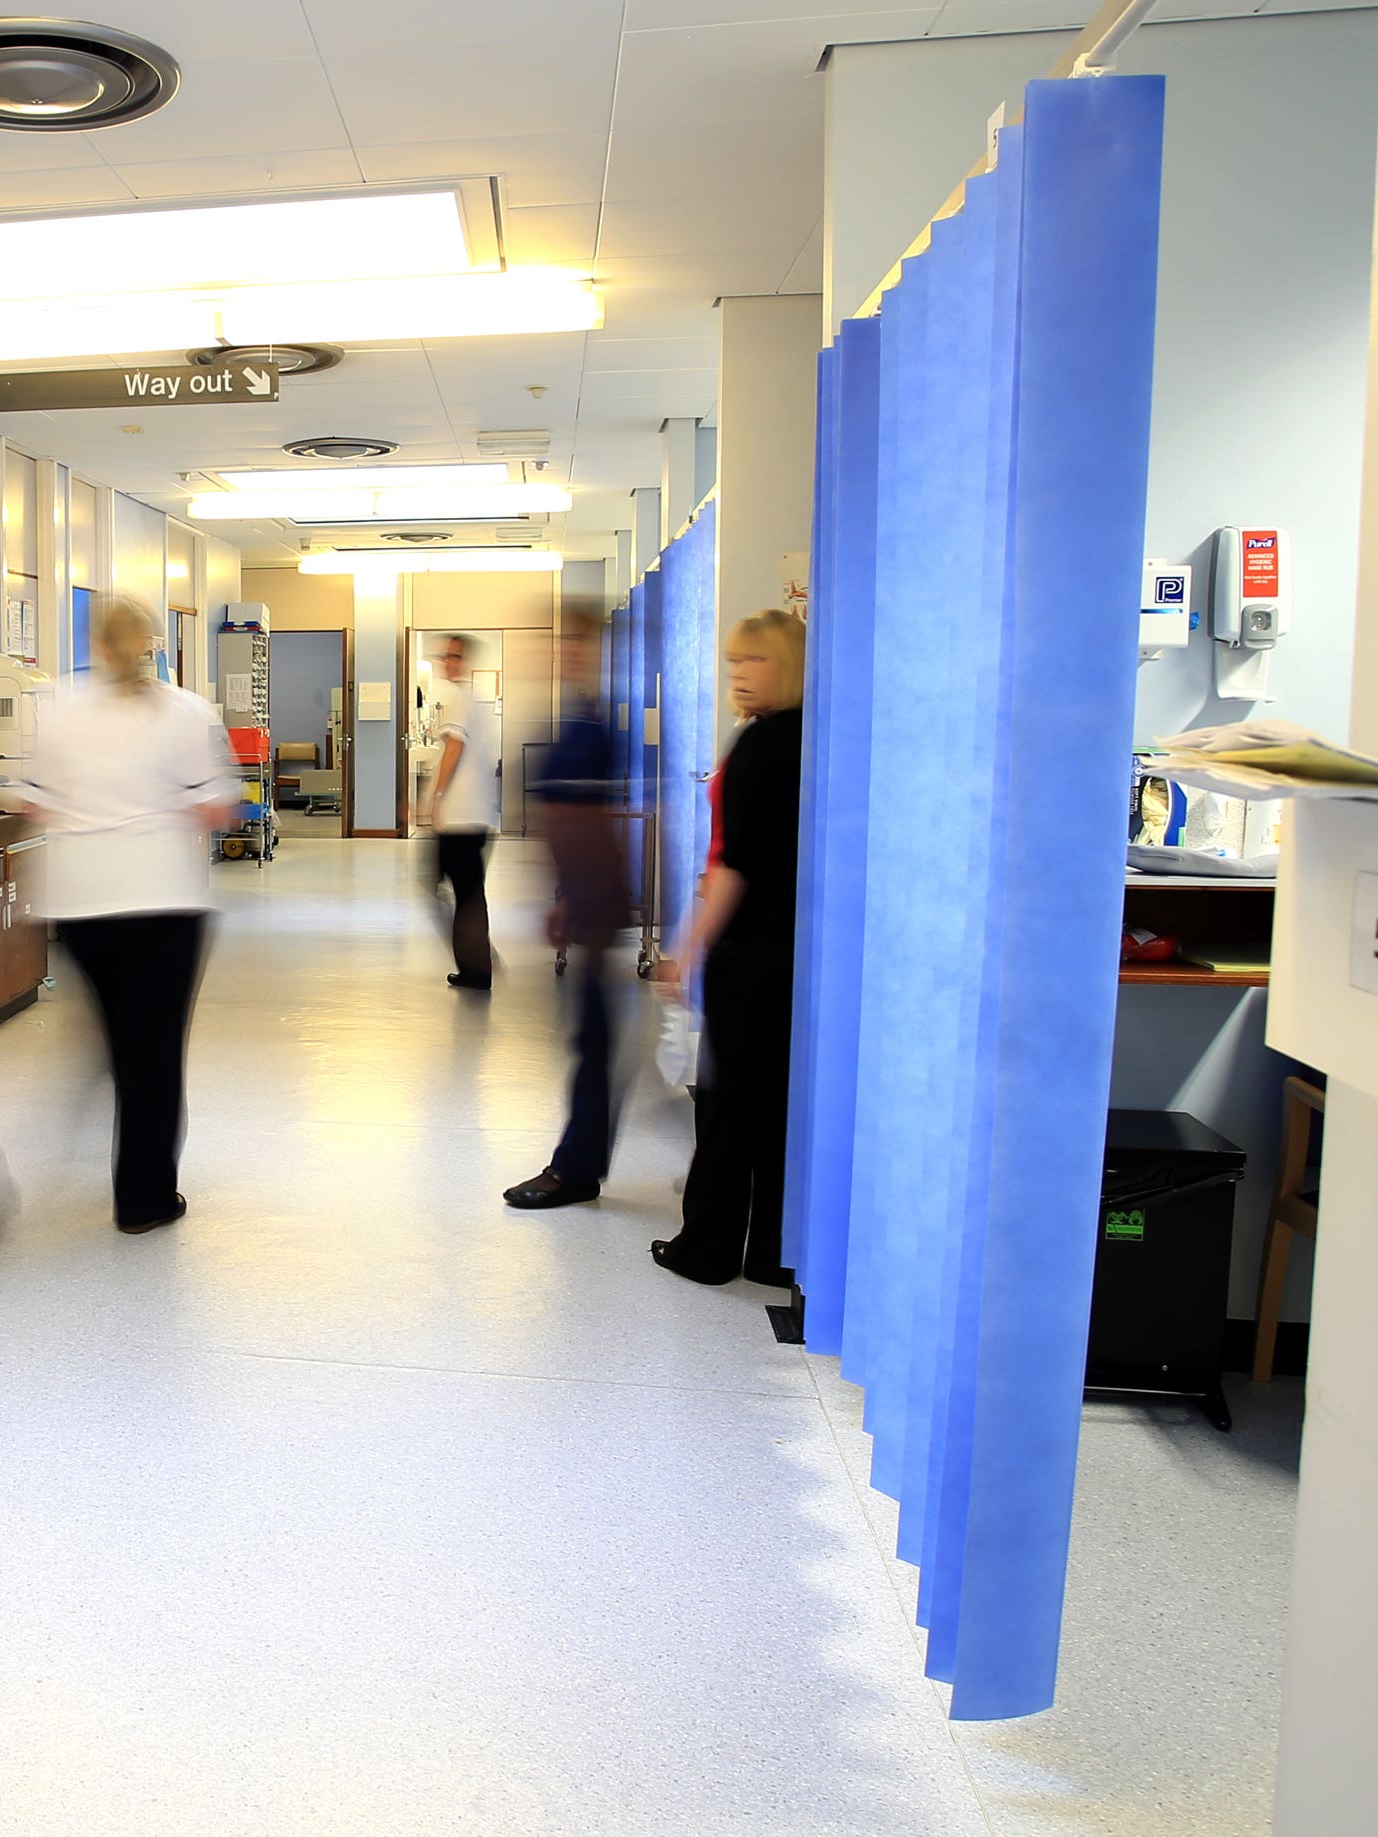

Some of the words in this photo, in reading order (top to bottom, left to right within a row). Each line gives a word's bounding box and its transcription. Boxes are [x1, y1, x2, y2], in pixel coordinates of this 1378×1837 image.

[124, 374, 181, 399] Way
[190, 369, 233, 393] out
[1248, 539, 1274, 548] Purell
